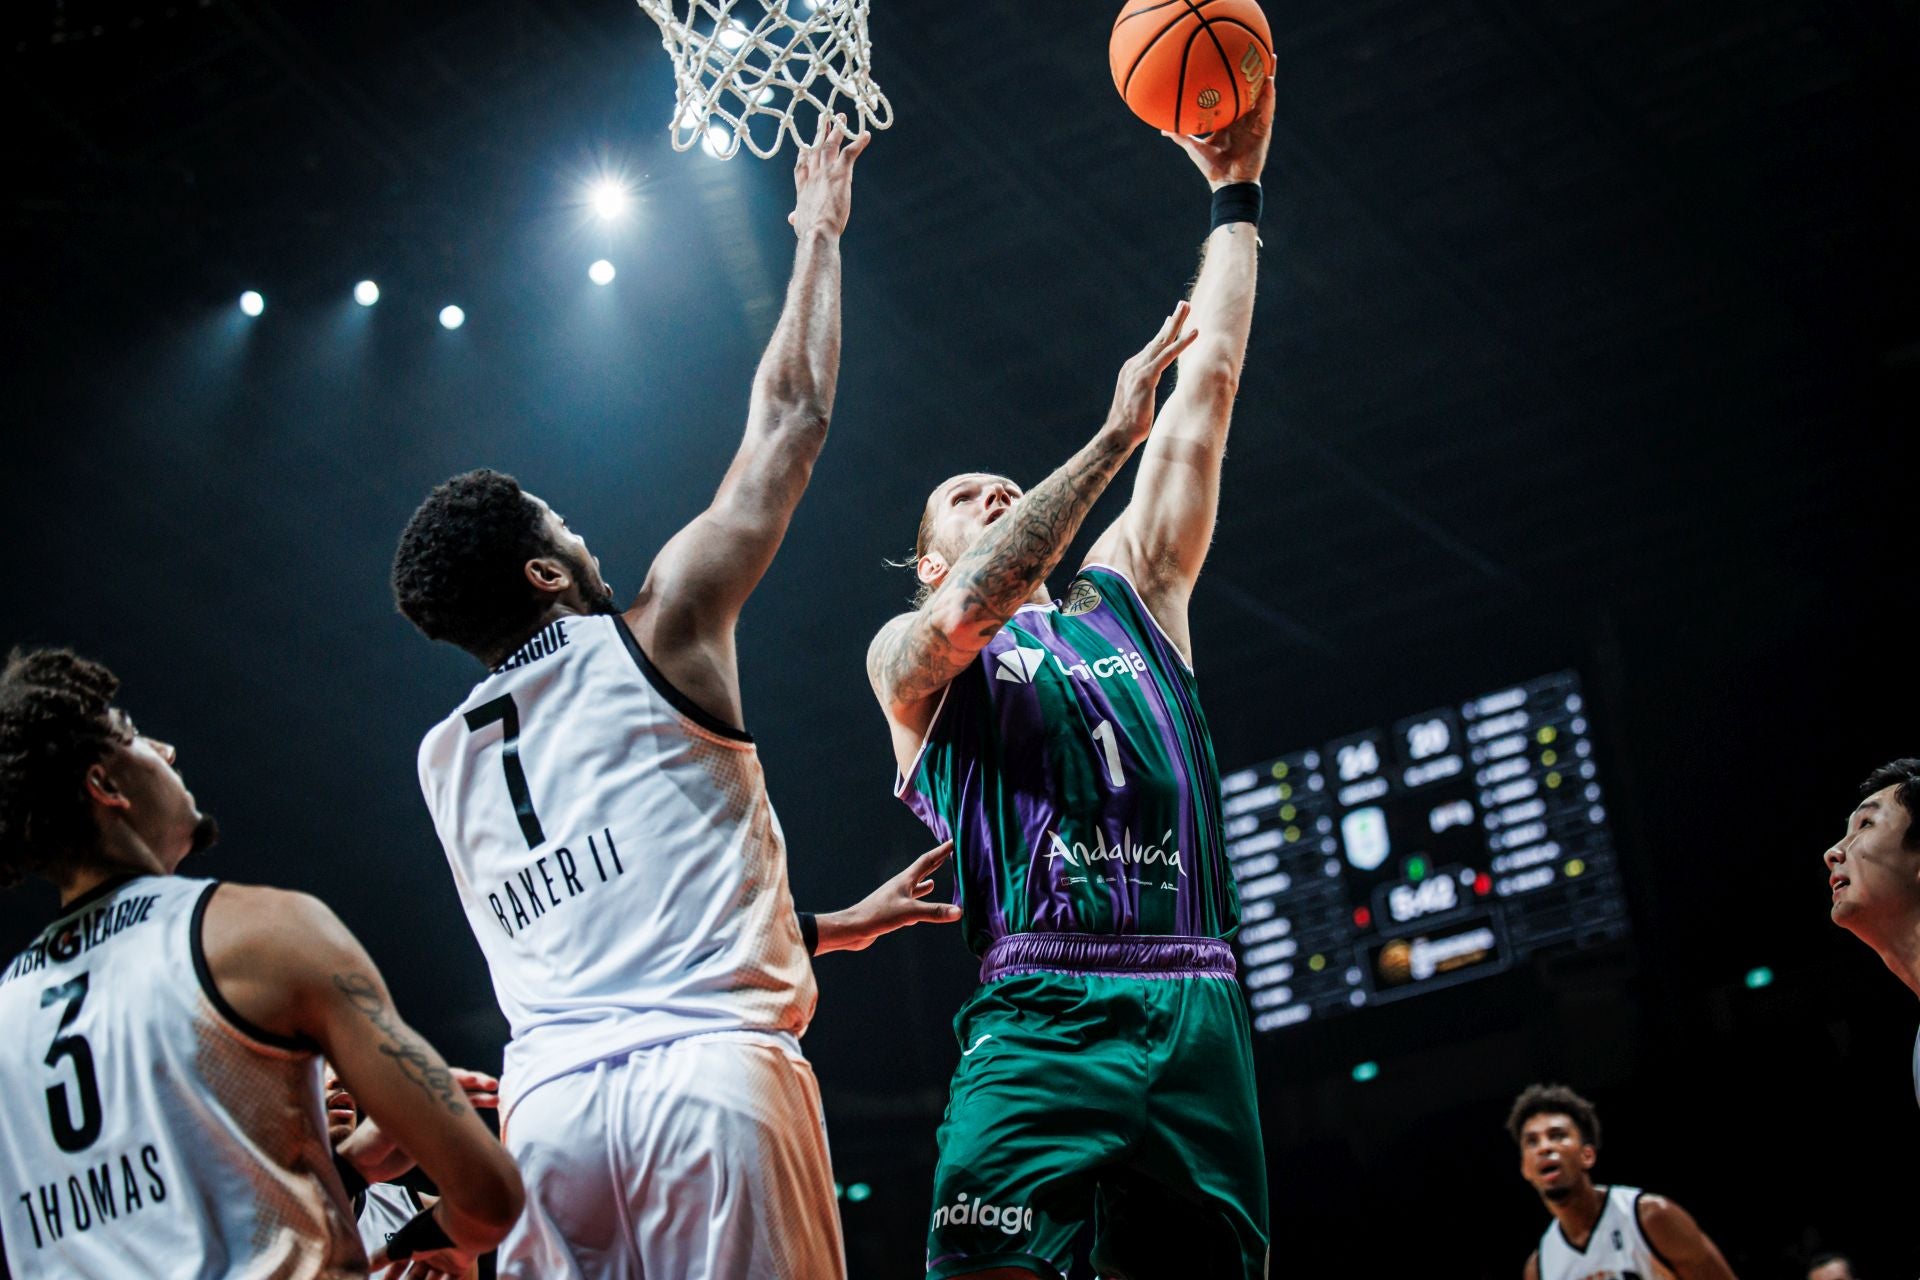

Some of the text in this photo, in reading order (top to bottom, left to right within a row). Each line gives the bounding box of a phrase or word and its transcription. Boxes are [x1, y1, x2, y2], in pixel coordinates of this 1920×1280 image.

[495, 621, 570, 675] AGUE
[463, 693, 546, 850] 7
[1092, 720, 1126, 787] 1
[488, 827, 624, 939] BAKER II
[1043, 825, 1187, 878] Andalucía
[40, 970, 102, 1155] 3
[19, 1144, 167, 1250] THOMAS
